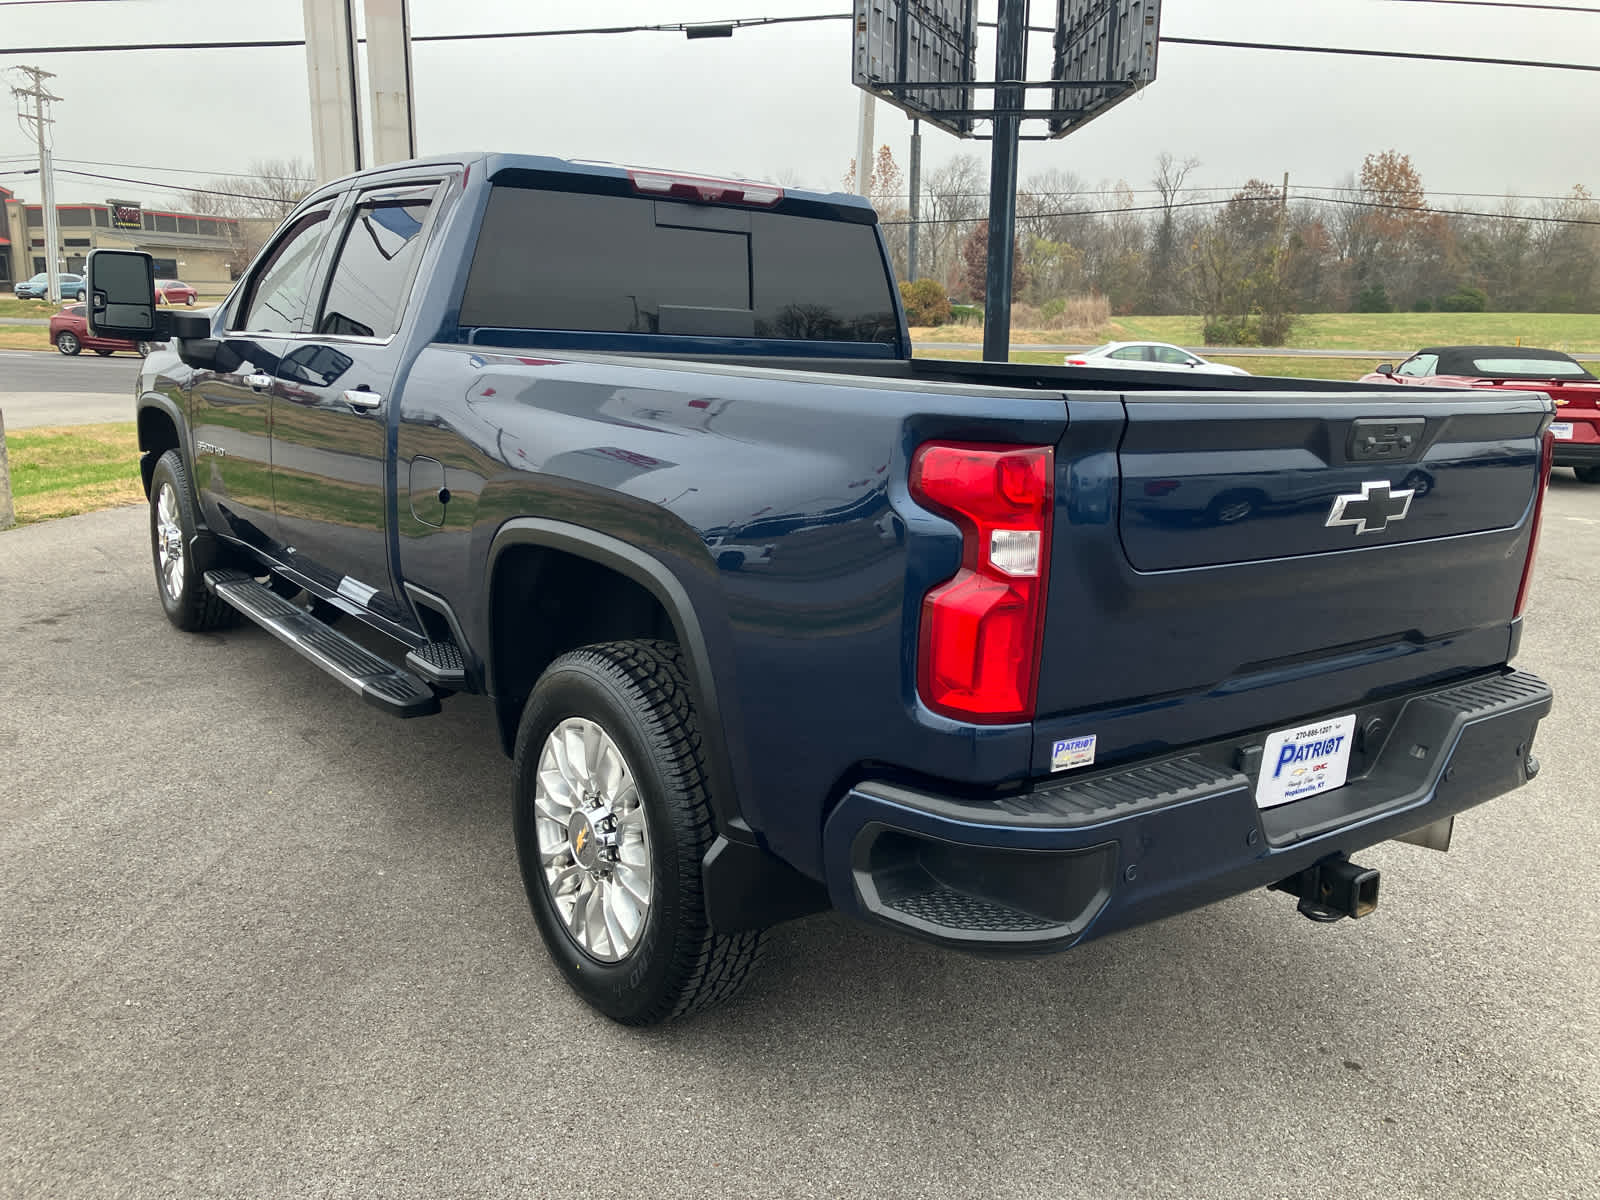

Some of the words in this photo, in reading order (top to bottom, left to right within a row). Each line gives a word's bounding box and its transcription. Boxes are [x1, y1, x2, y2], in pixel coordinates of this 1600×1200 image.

[1054, 738, 1094, 758] PATRIOT
[1273, 736, 1345, 778] PATRIOT
[1312, 762, 1328, 772] GMC
[1317, 781, 1325, 789] KY
